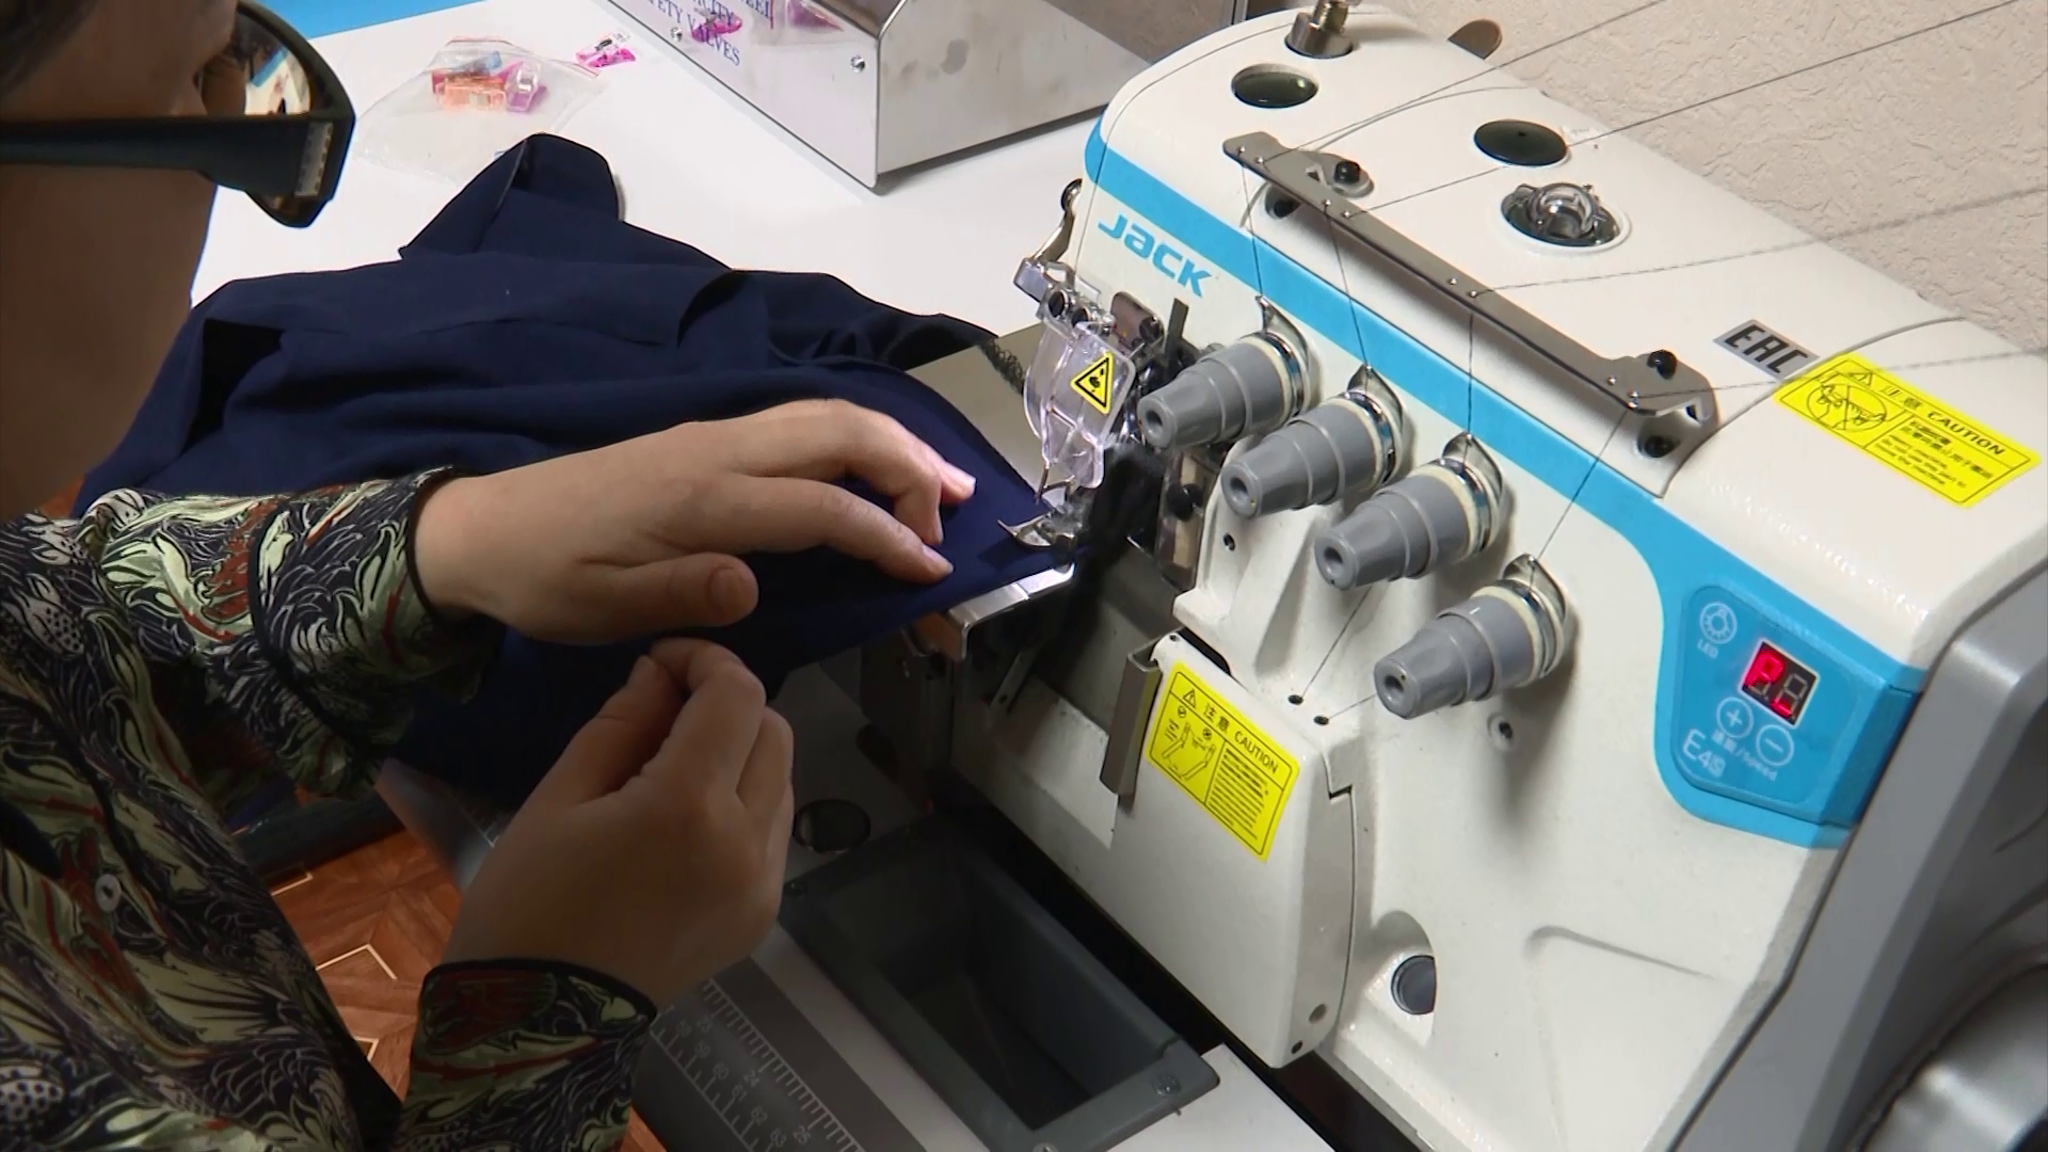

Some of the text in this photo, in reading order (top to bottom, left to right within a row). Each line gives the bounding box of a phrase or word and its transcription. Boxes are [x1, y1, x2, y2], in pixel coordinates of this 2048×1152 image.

[688, 14, 740, 66] VALVES
[1723, 323, 1809, 374] EAC
[1927, 410, 2006, 456] CAUTION
[1234, 730, 1278, 774] CAUTION
